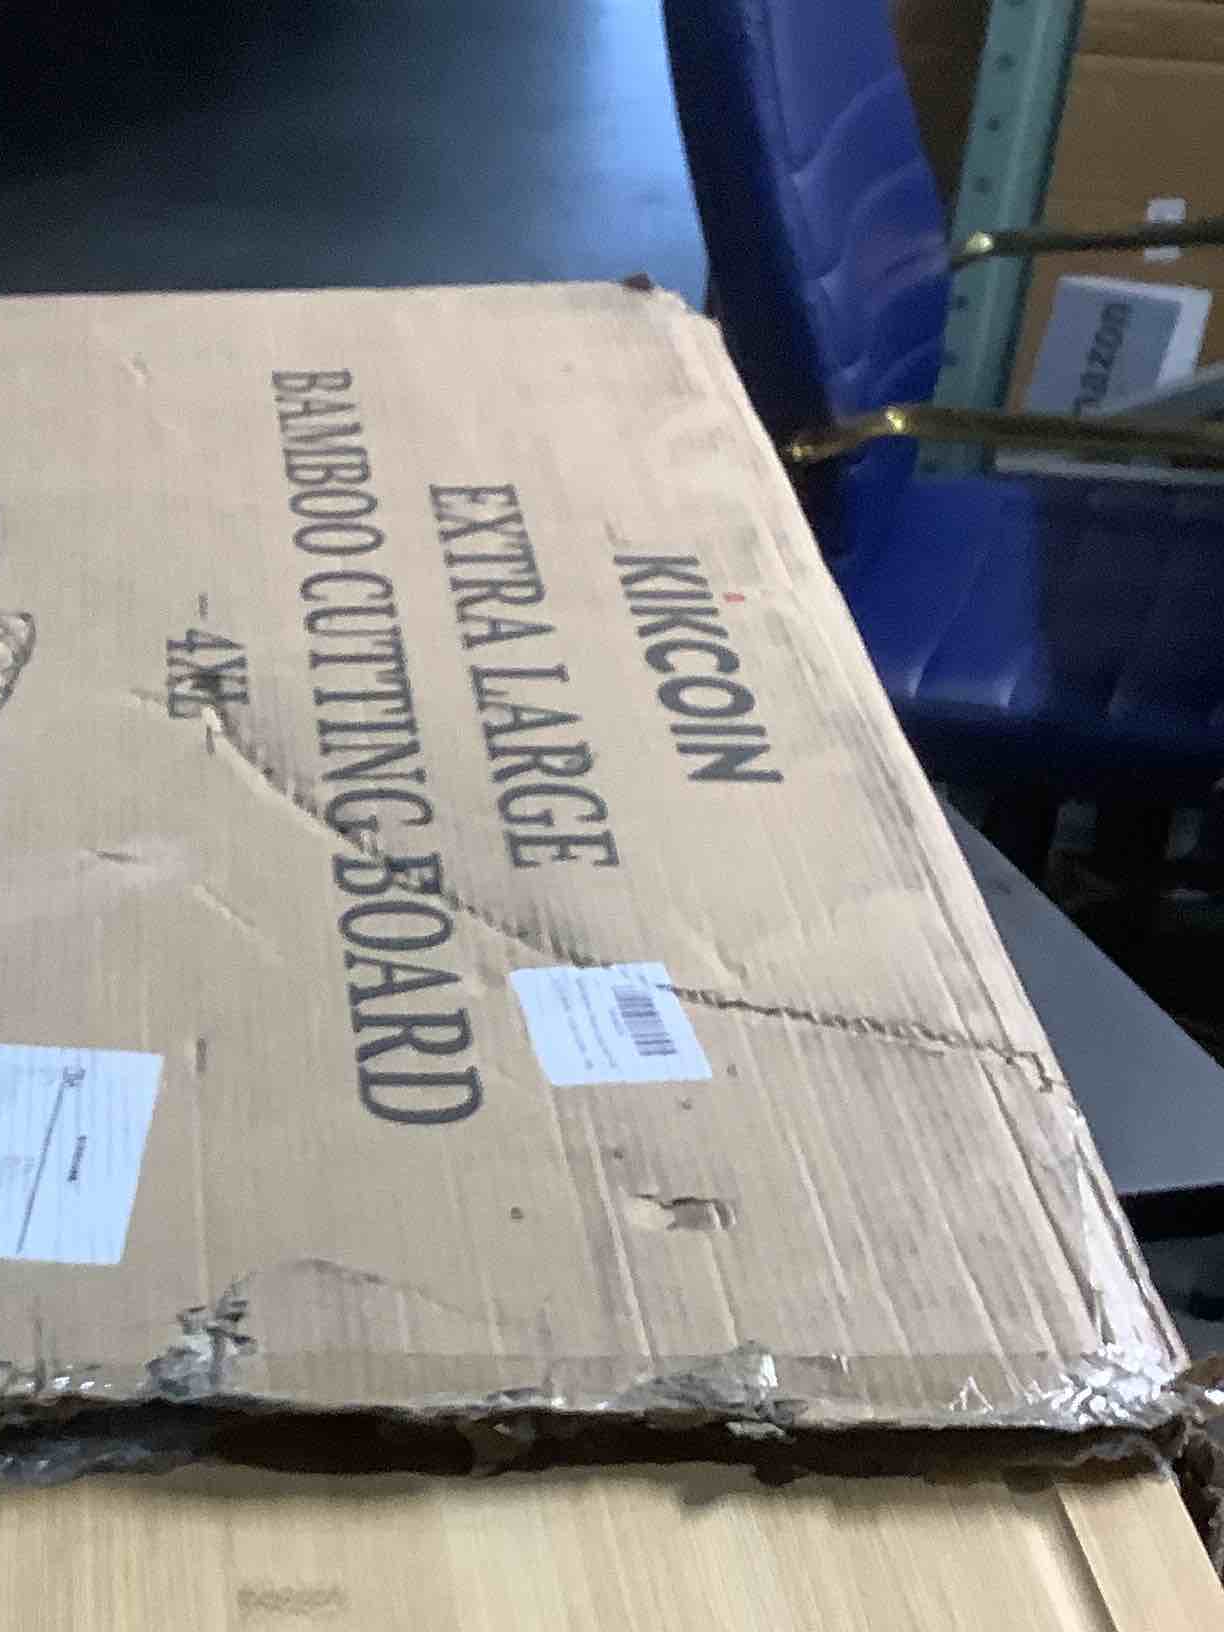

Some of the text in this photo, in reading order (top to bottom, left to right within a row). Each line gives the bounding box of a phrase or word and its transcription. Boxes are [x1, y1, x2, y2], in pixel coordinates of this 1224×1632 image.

[272, 368, 483, 1126] BAMBOO CUTTING BOARD
[428, 484, 620, 868] EXTRA LARGE
